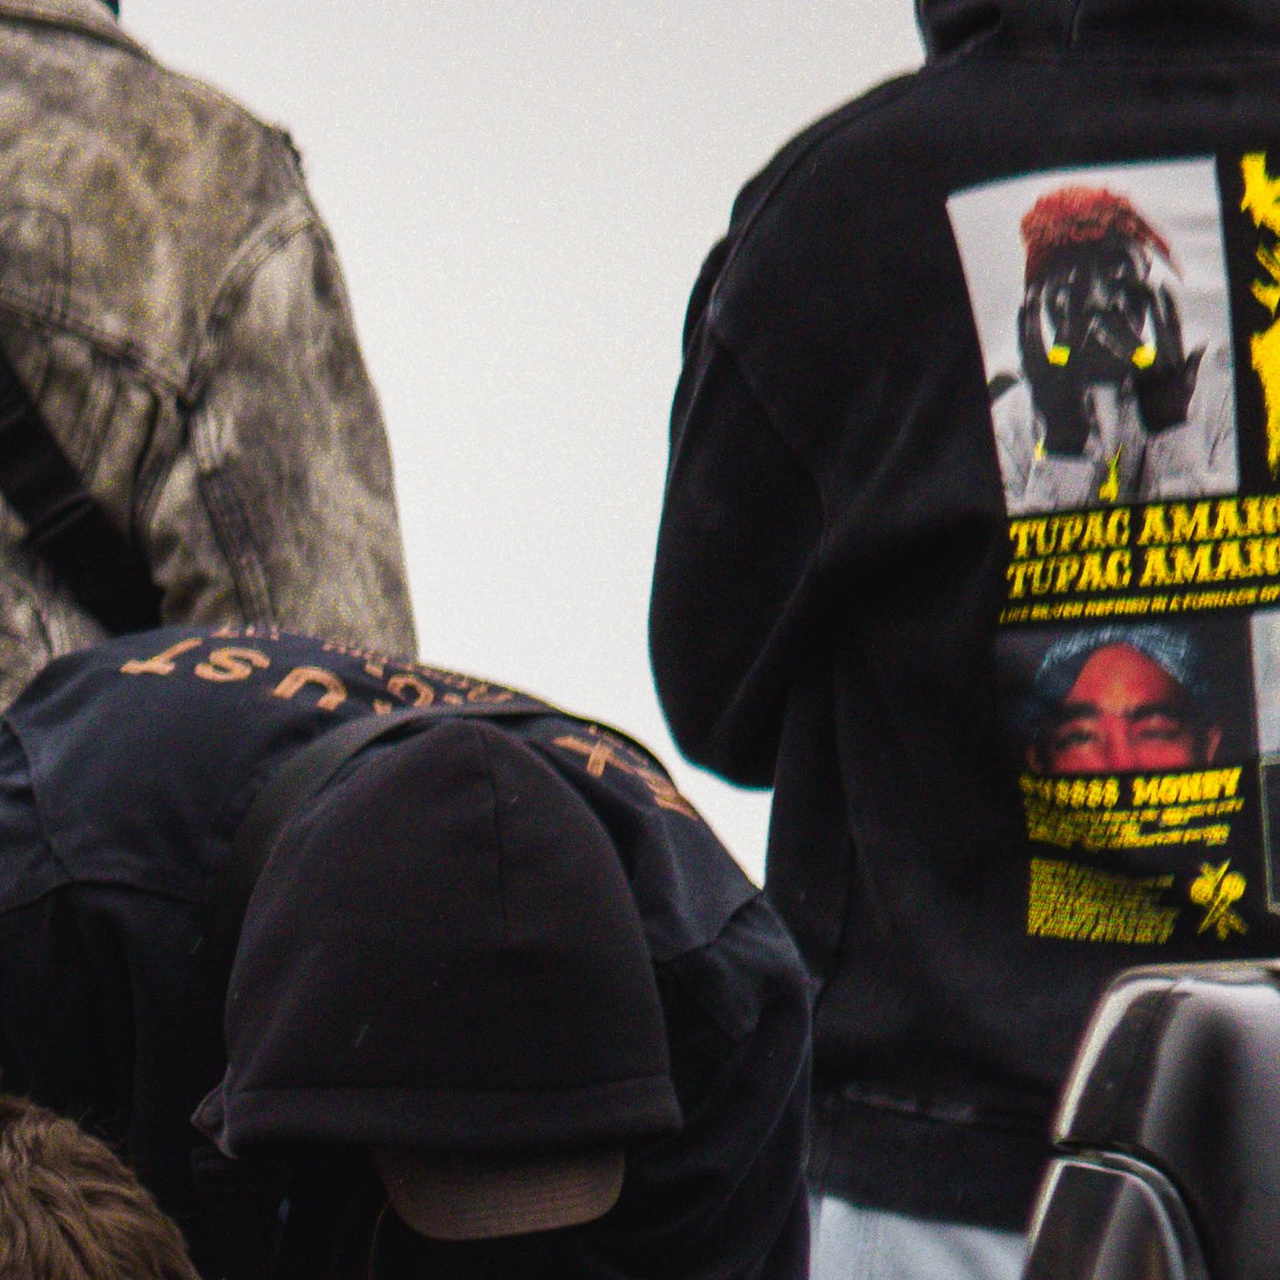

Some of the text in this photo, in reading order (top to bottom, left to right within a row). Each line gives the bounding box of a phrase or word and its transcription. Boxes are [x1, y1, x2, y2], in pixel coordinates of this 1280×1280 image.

[1008, 495, 1280, 559] TUPAC AMAR
[1006, 536, 1280, 599] TUPAC AMAR
